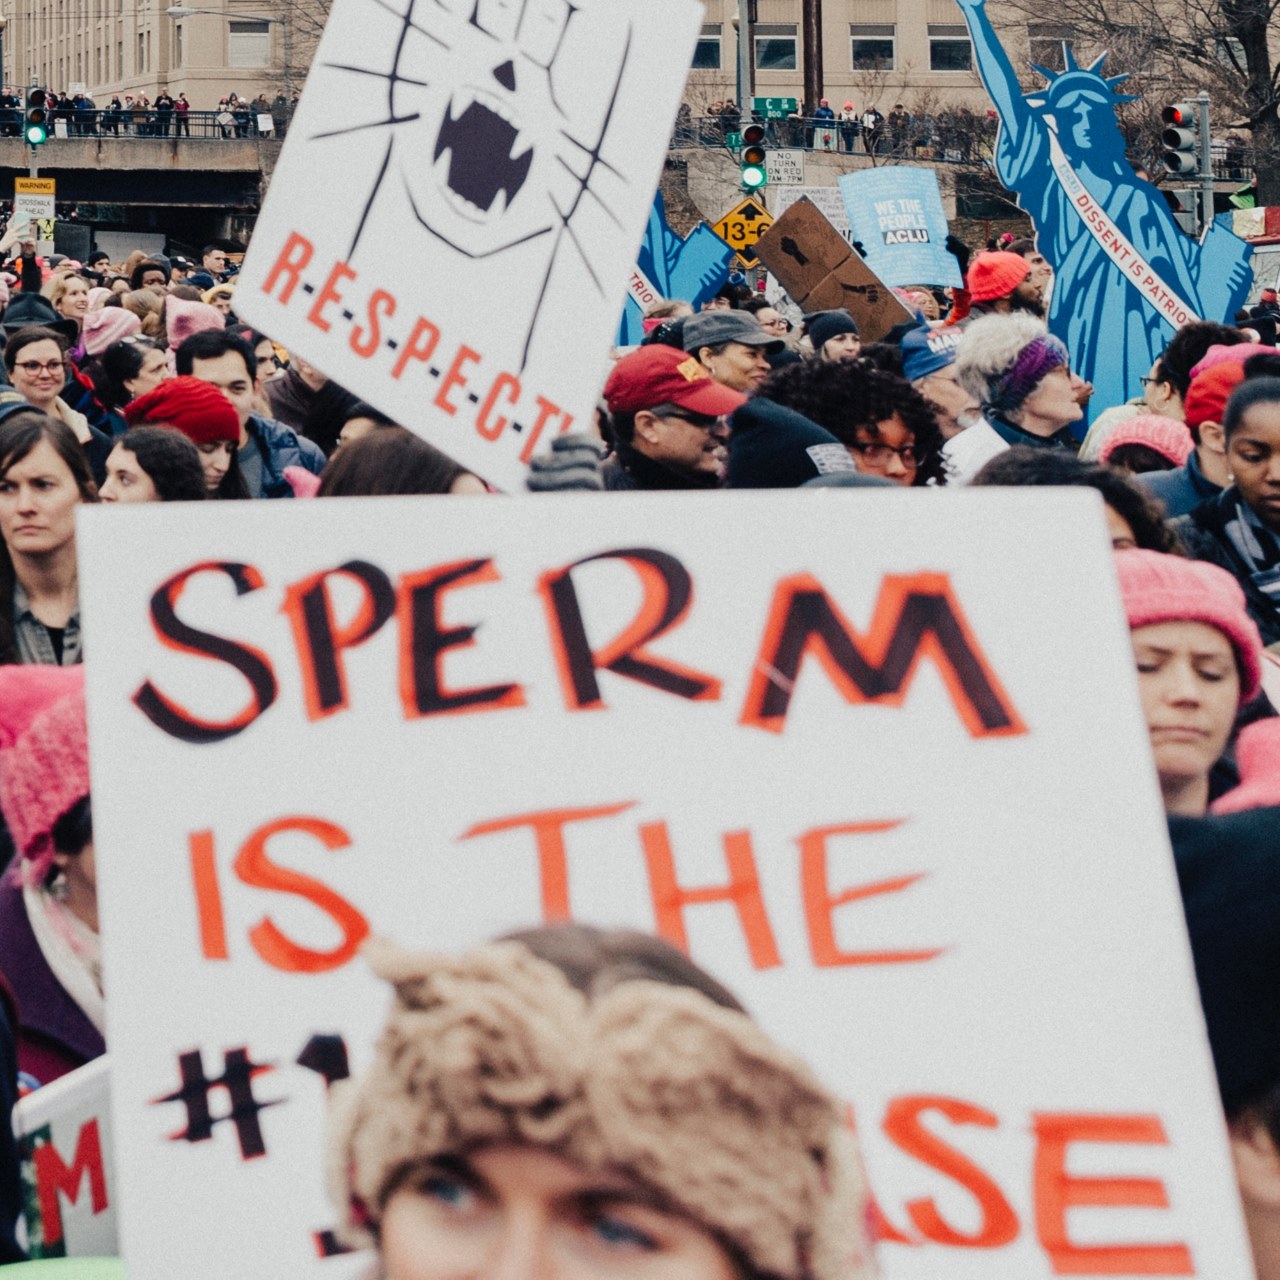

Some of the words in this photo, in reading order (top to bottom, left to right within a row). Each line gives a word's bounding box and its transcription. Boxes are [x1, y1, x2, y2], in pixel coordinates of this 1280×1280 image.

[765, 98, 773, 110] C
[767, 110, 782, 118] 800
[777, 152, 792, 160] NO
[19, 182, 51, 190] WARNING
[18, 199, 51, 207] CROSSWALK
[874, 200, 898, 216] WE
[897, 198, 924, 214] THE
[878, 213, 928, 231] PEOPLE
[885, 229, 929, 245] ACLU
[1076, 194, 1131, 261] DISSENT
[1129, 260, 1145, 277] IS
[1142, 275, 1193, 325] PATRIO
[629, 272, 657, 305] TRIO
[130, 546, 1028, 744] SPERM
[186, 814, 371, 974] IS
[456, 798, 961, 972] THE
